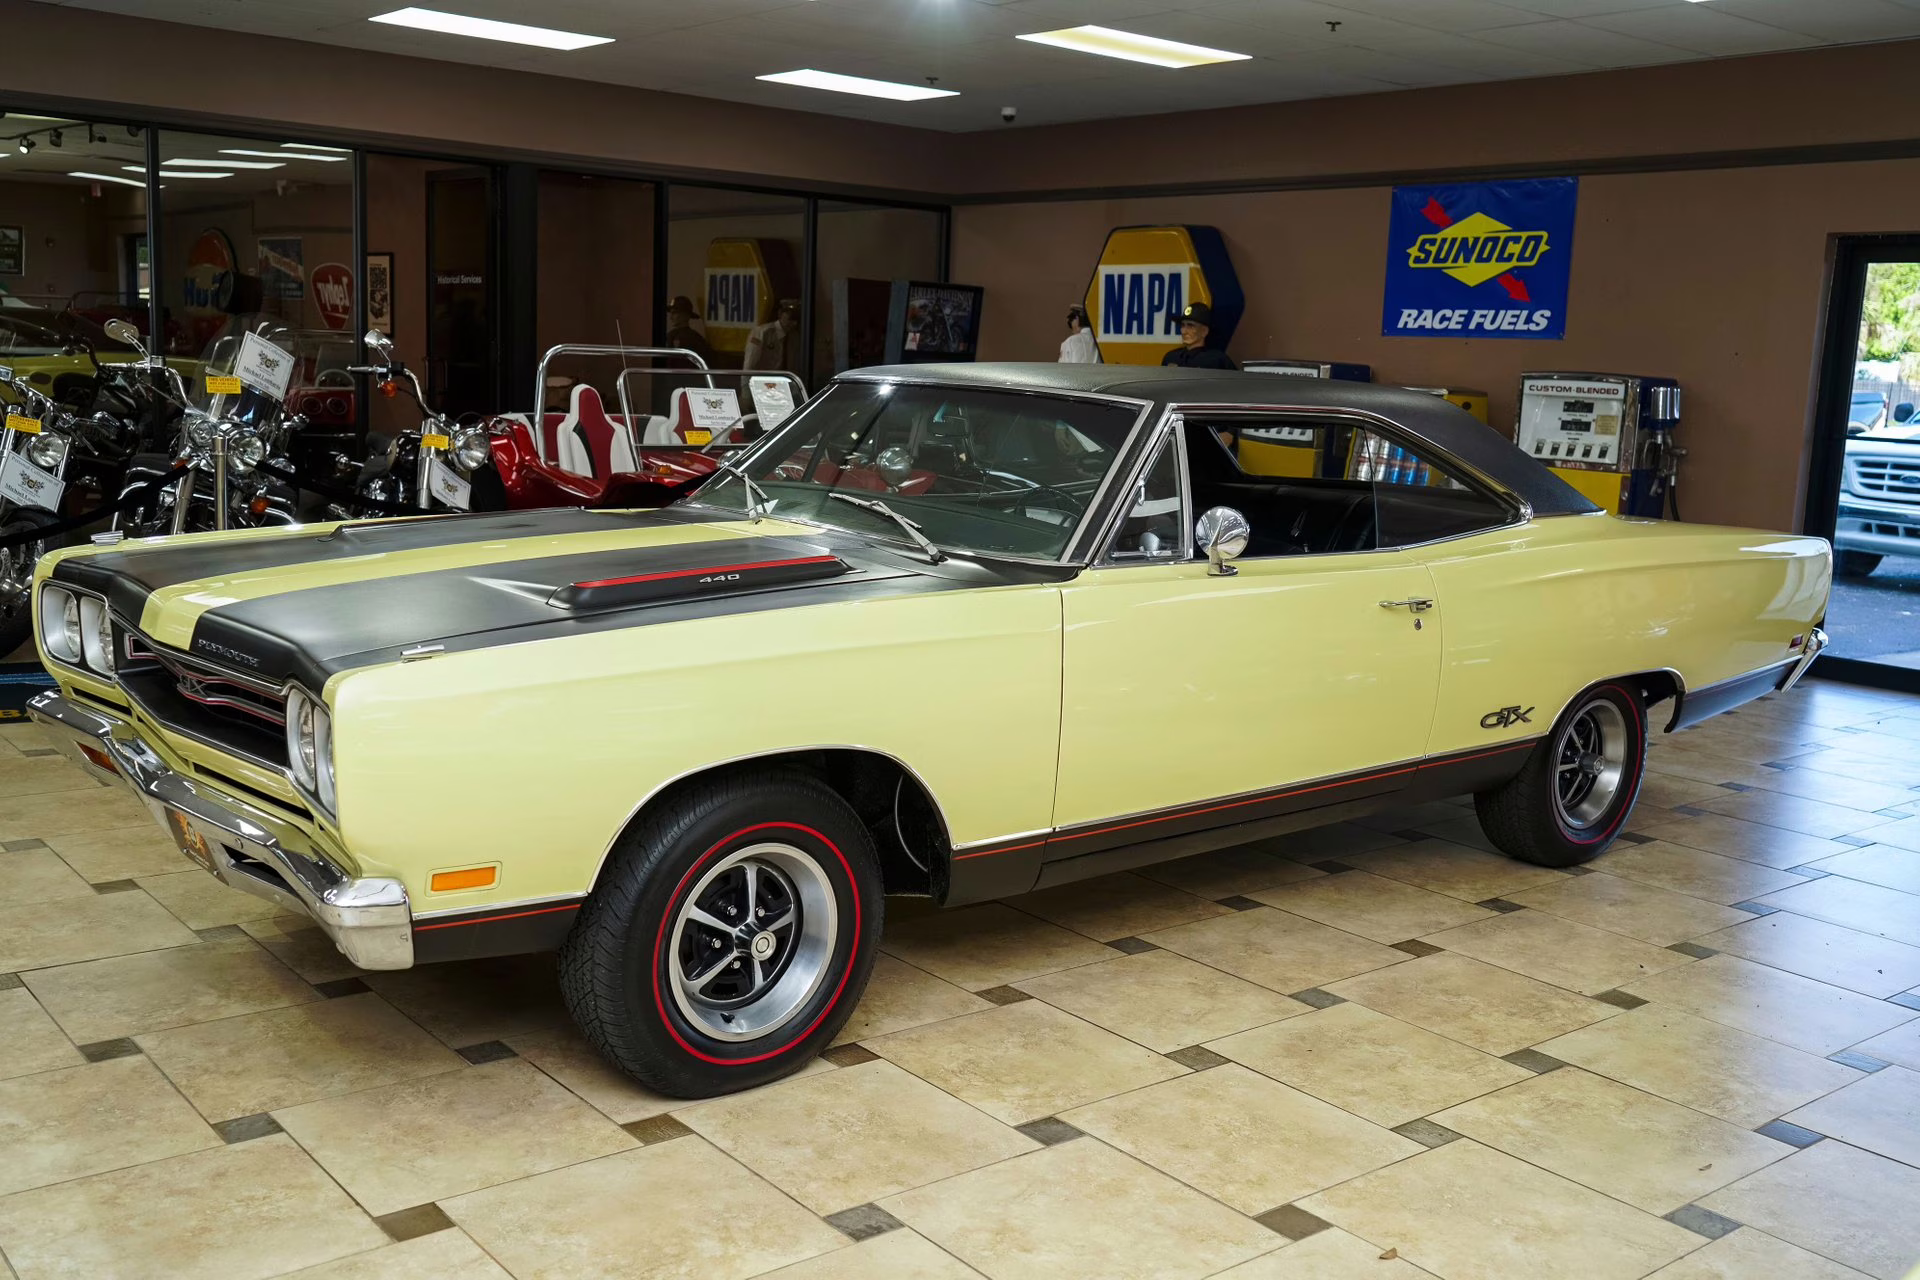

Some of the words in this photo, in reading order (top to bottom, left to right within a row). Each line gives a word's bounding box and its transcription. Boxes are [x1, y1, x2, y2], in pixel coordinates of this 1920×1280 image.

[1412, 235, 1544, 264] SUNOCO
[460, 274, 482, 284] Services
[1104, 273, 1183, 335] NAPA
[1397, 308, 1469, 329] RACE
[1468, 309, 1551, 331] FUELS
[699, 574, 740, 583] 440
[1480, 705, 1535, 729] GTX
